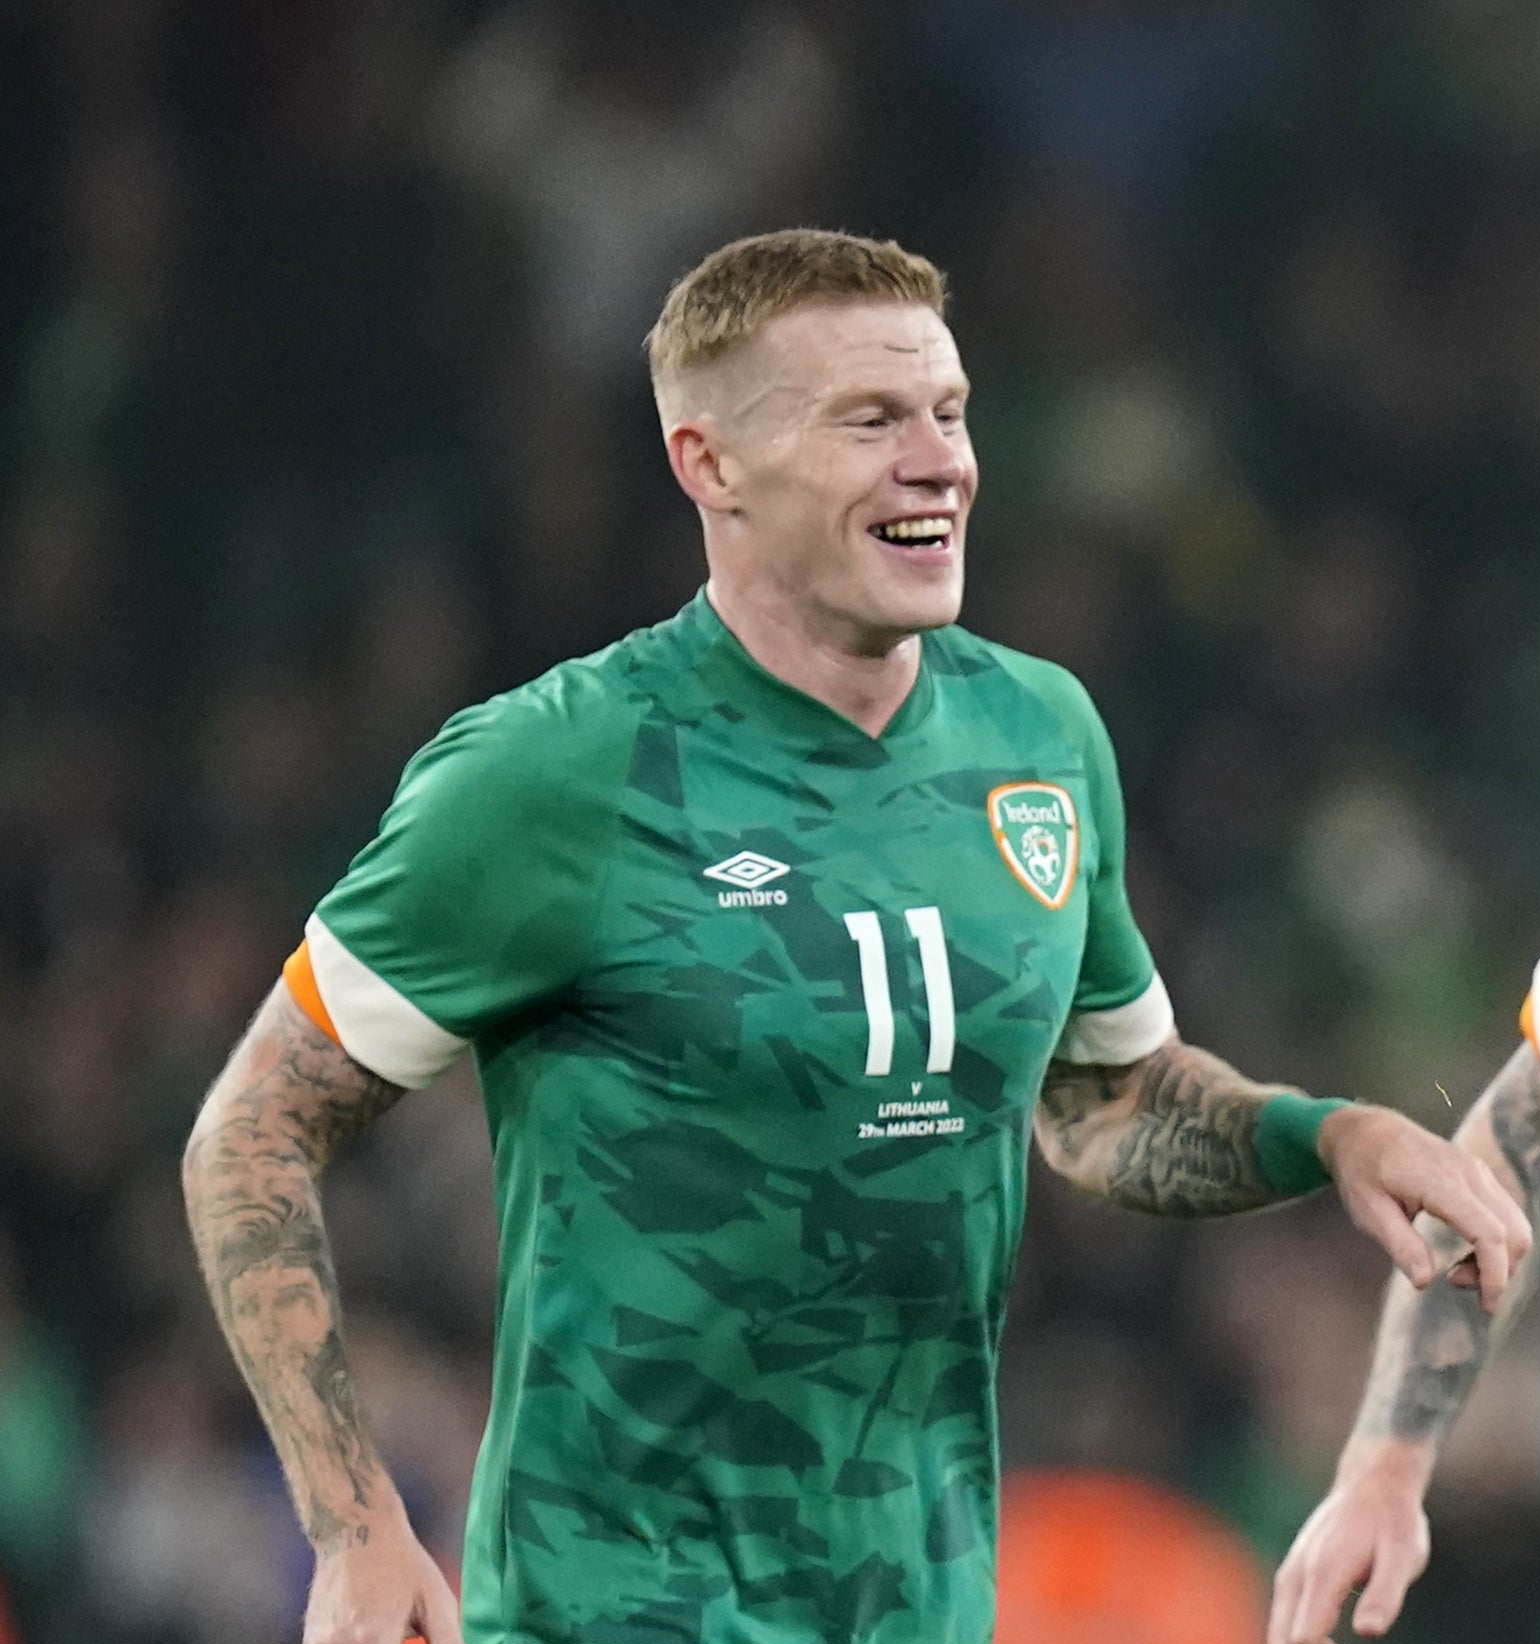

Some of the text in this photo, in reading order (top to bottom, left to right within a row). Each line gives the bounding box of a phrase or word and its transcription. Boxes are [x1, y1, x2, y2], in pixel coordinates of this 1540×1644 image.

[1002, 800, 1060, 824] Ireland
[718, 889, 788, 908] umbro
[843, 906, 956, 1076] 11
[878, 1100, 949, 1118] LITHUANIA
[886, 1120, 935, 1138] MARCH
[935, 1116, 965, 1135] 2022
